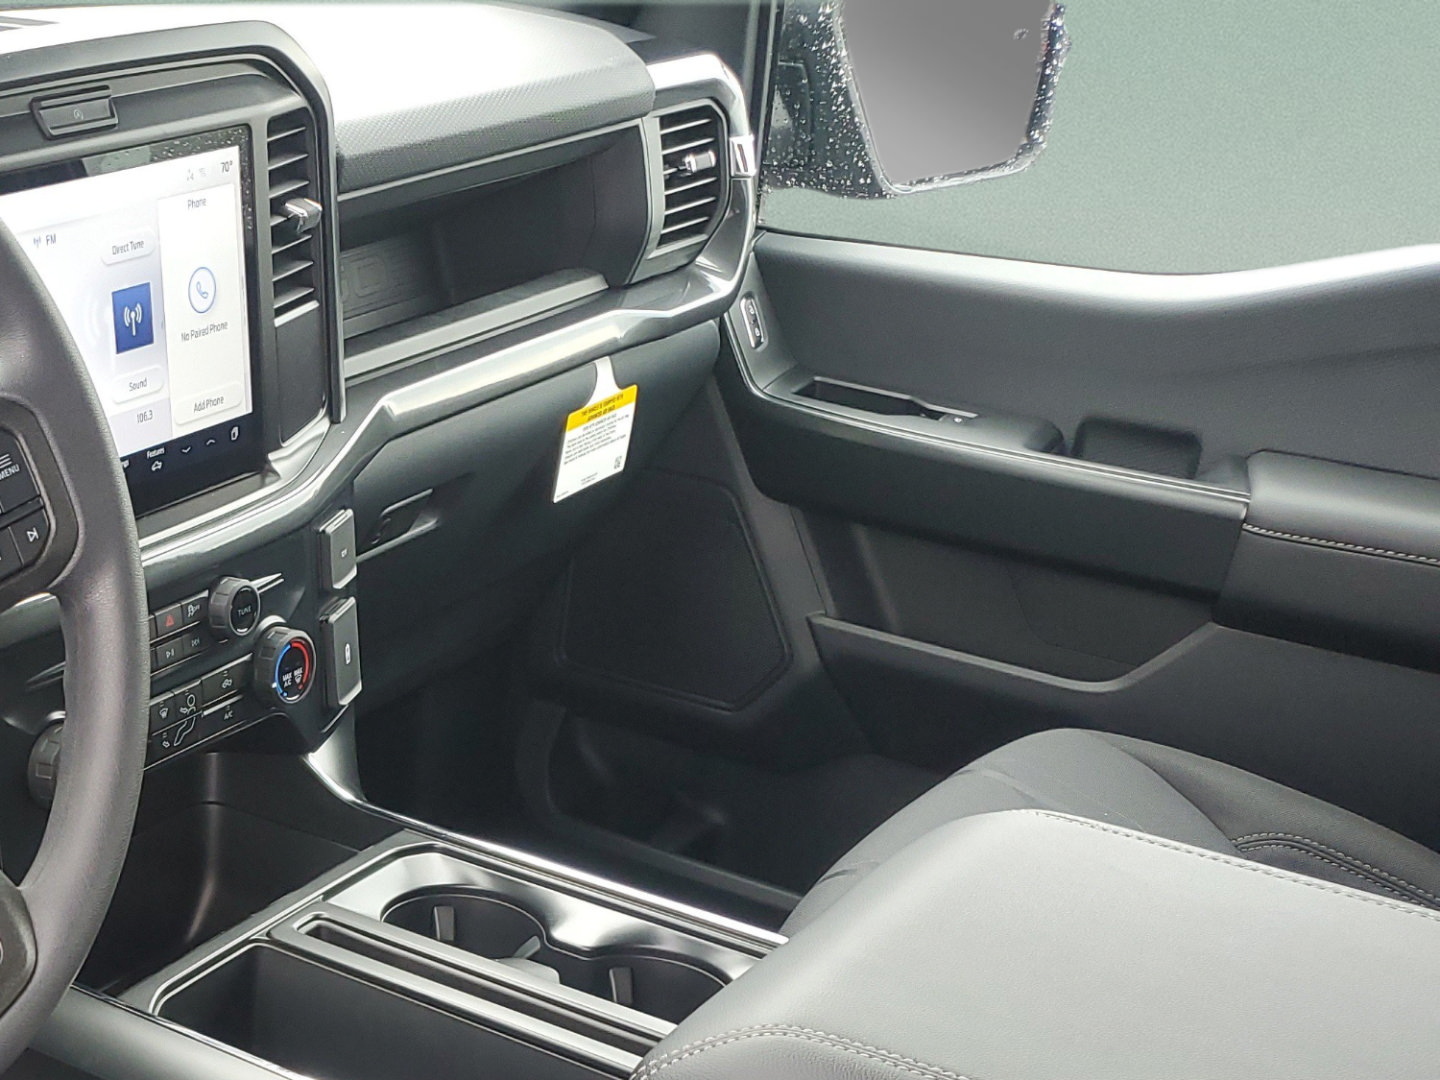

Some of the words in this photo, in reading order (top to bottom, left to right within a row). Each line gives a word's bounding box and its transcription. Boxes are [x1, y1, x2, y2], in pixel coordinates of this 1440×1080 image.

[187, 197, 207, 210] Phone
[46, 233, 57, 246] FM
[112, 241, 129, 255] Direct
[130, 239, 145, 252] Tune
[181, 331, 190, 342] No
[191, 326, 209, 339] Paired
[210, 320, 228, 334] Phone
[129, 378, 148, 392] Sound
[194, 401, 205, 414] Add
[206, 395, 225, 410] Phone
[137, 410, 153, 424] 106.3
[237, 605, 252, 618] TUNE
[282, 671, 293, 682] MAX
